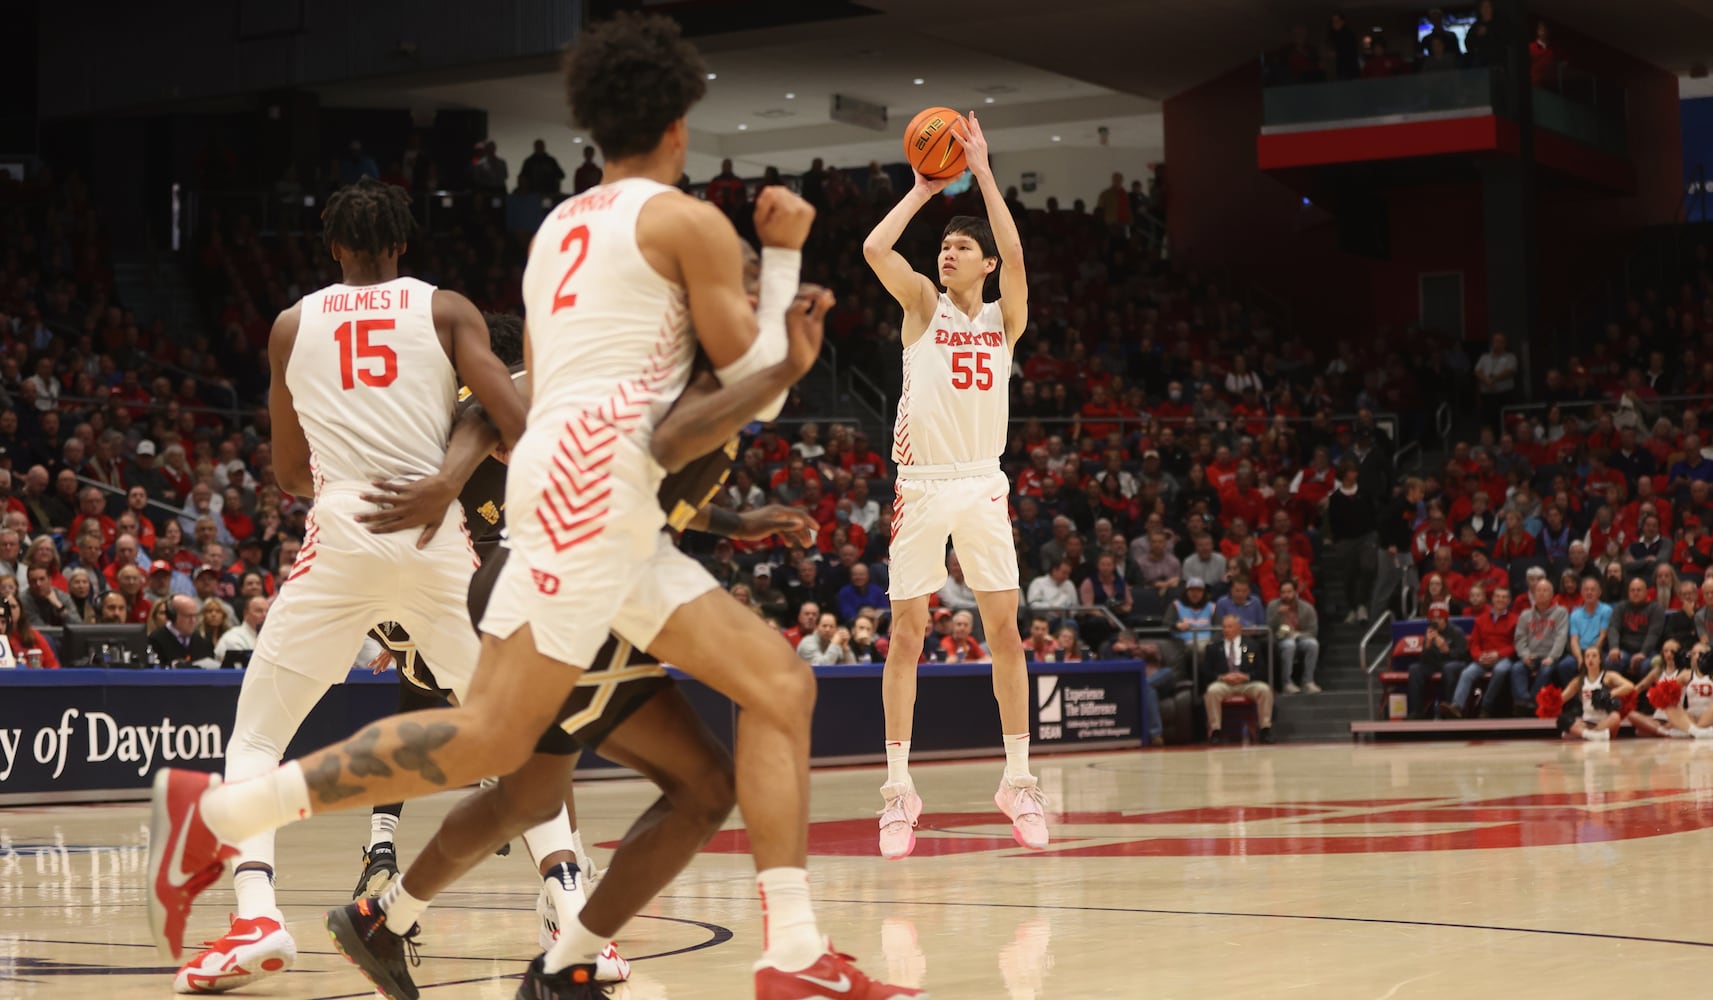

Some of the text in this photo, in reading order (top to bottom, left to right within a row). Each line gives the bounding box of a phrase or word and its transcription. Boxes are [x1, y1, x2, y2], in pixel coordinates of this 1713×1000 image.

[915, 117, 946, 151] ELITE
[551, 224, 590, 315] 2
[322, 288, 410, 314] HOLMES II
[334, 318, 398, 391] 15
[934, 328, 1003, 347] DAYTON
[951, 351, 994, 391] 55
[33, 707, 79, 780] of
[84, 711, 225, 777] Dayton
